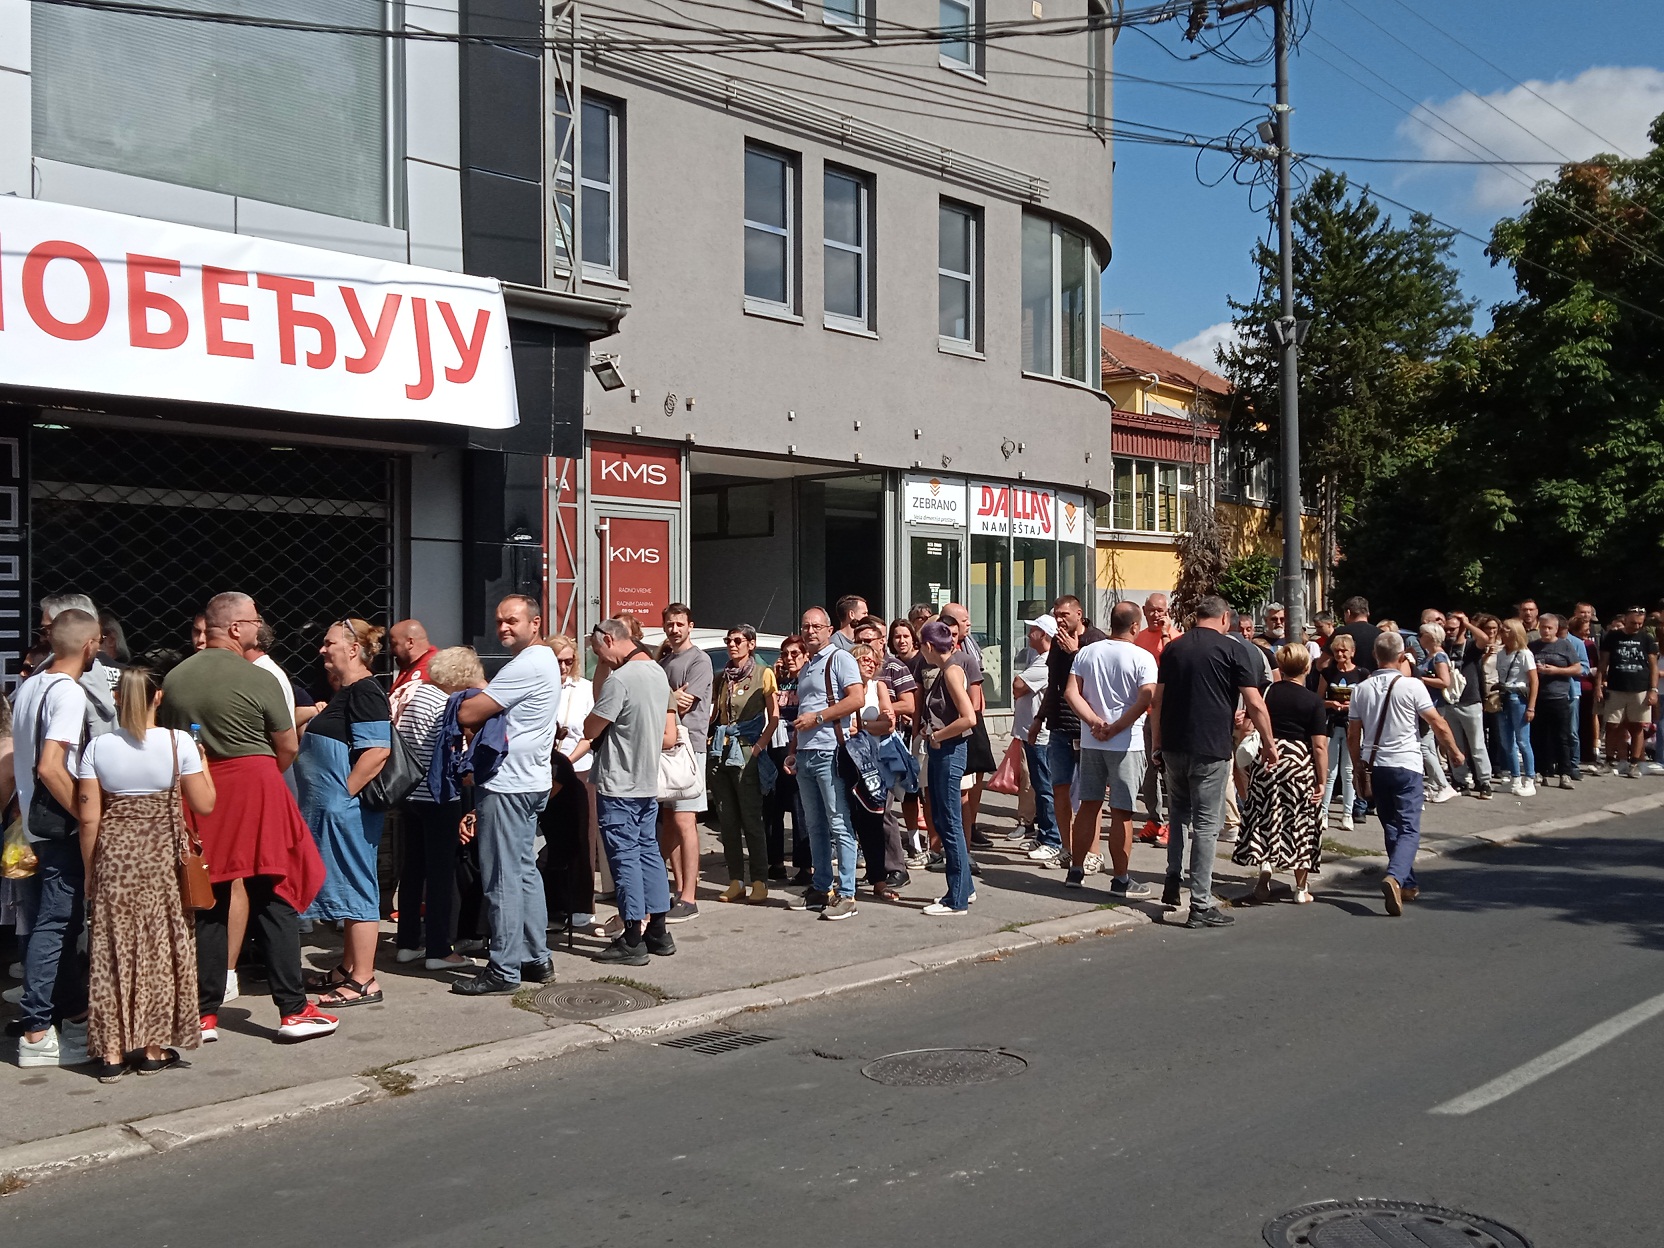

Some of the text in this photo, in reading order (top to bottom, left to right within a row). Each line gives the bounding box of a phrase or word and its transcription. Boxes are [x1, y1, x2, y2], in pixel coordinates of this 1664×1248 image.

[0, 231, 491, 400] ОБЕЂУЈУ
[601, 459, 667, 485] KMS
[912, 496, 957, 511] ZEBRANO
[977, 485, 1051, 534] DALLAS
[982, 521, 1040, 535] NAMEŠTAJ
[610, 546, 660, 564] KMS
